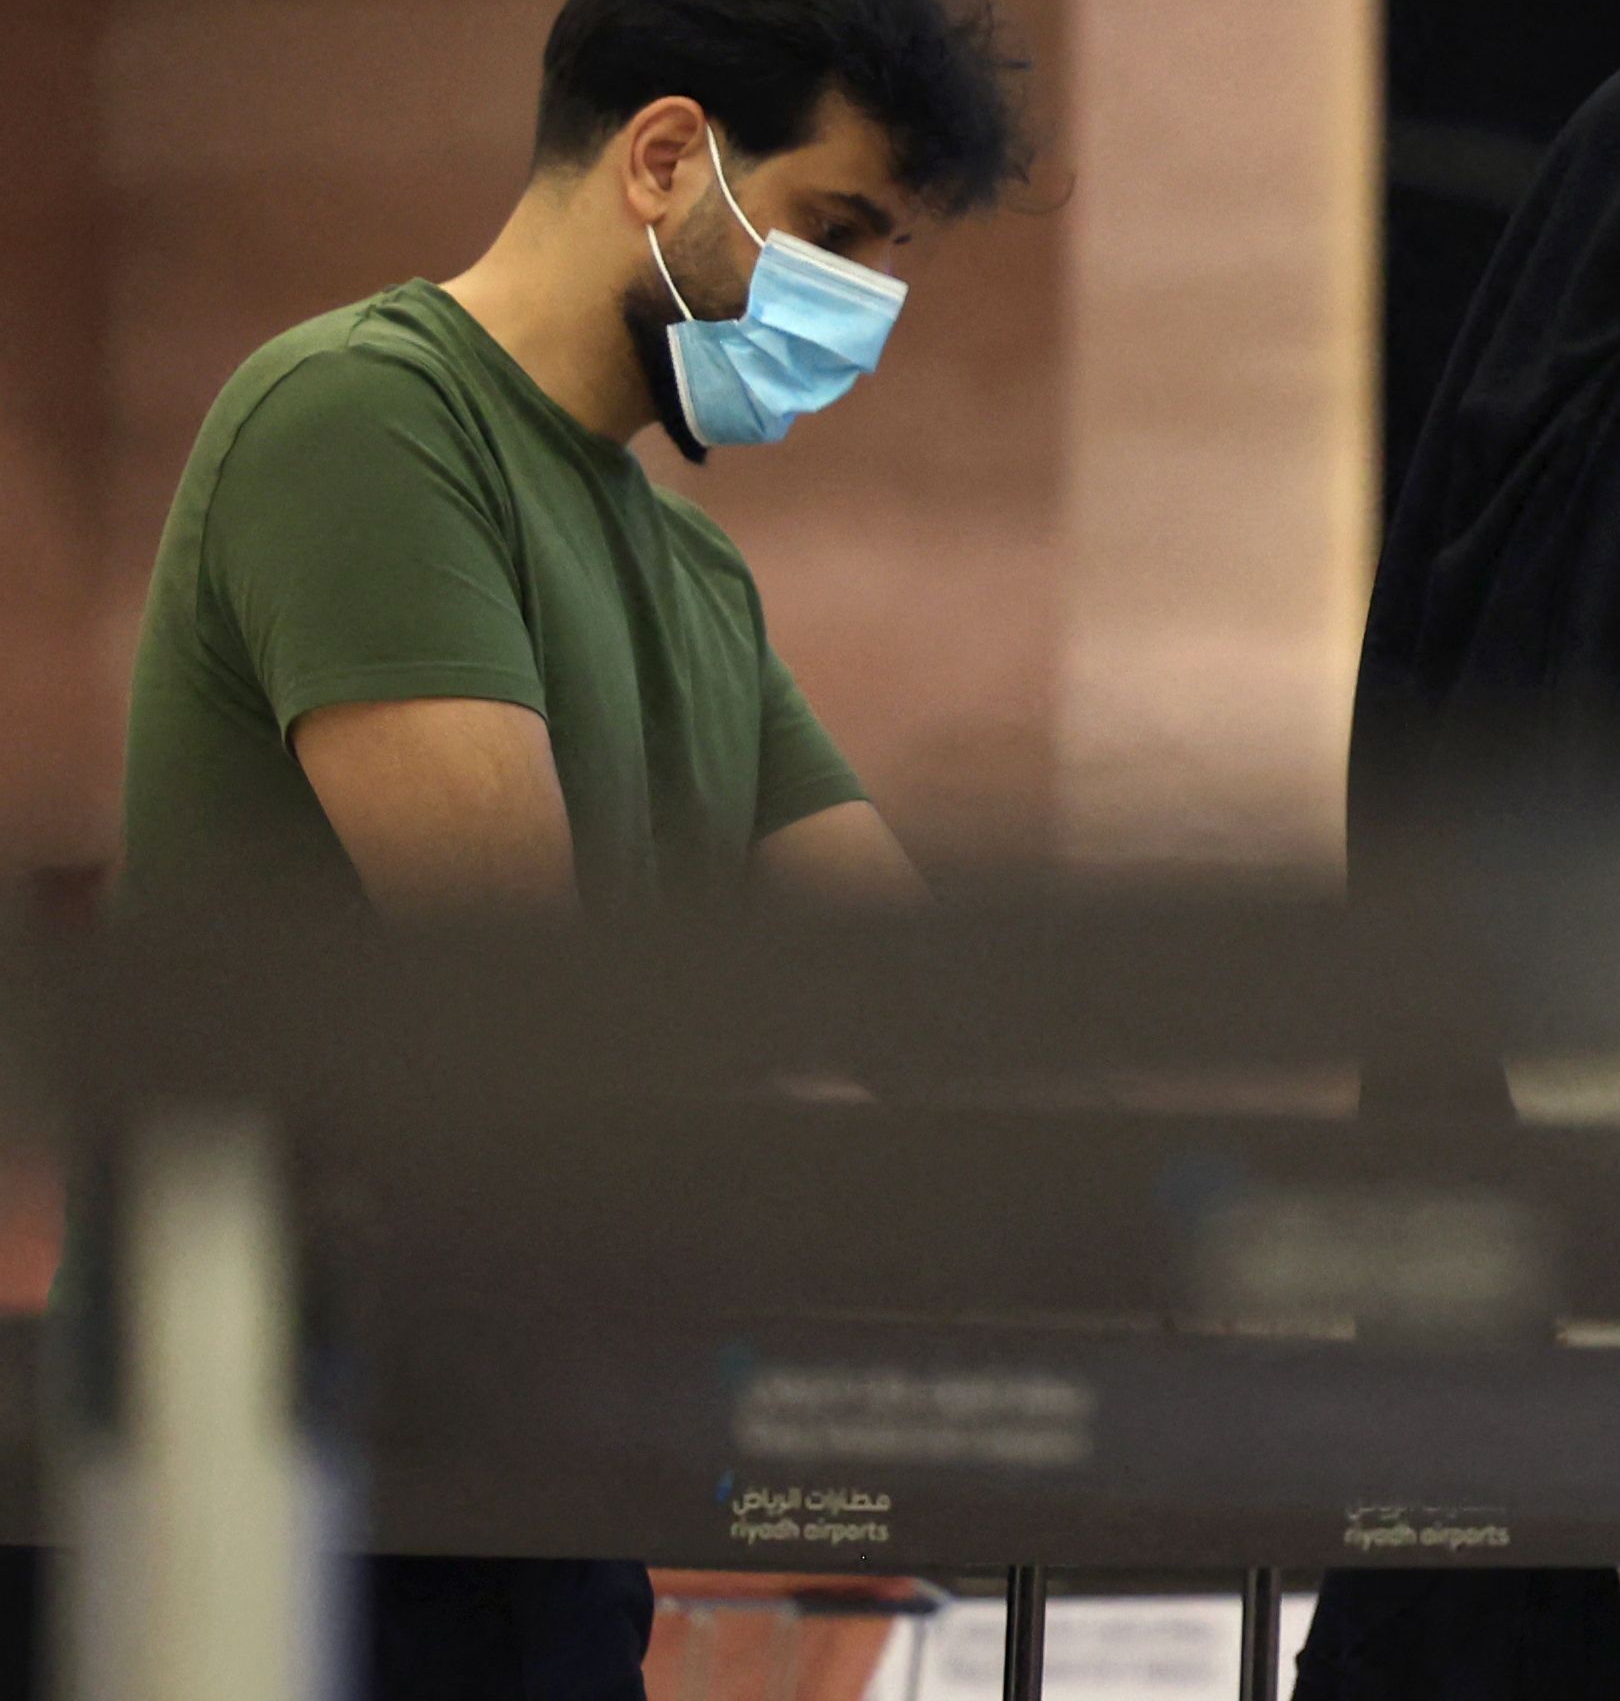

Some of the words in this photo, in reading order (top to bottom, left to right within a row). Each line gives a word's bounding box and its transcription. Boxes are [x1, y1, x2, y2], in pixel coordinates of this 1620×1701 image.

[730, 1517, 800, 1545] riyadh
[803, 1517, 889, 1545] airports
[1344, 1521, 1417, 1551] riyadh
[1419, 1521, 1511, 1551] airports
